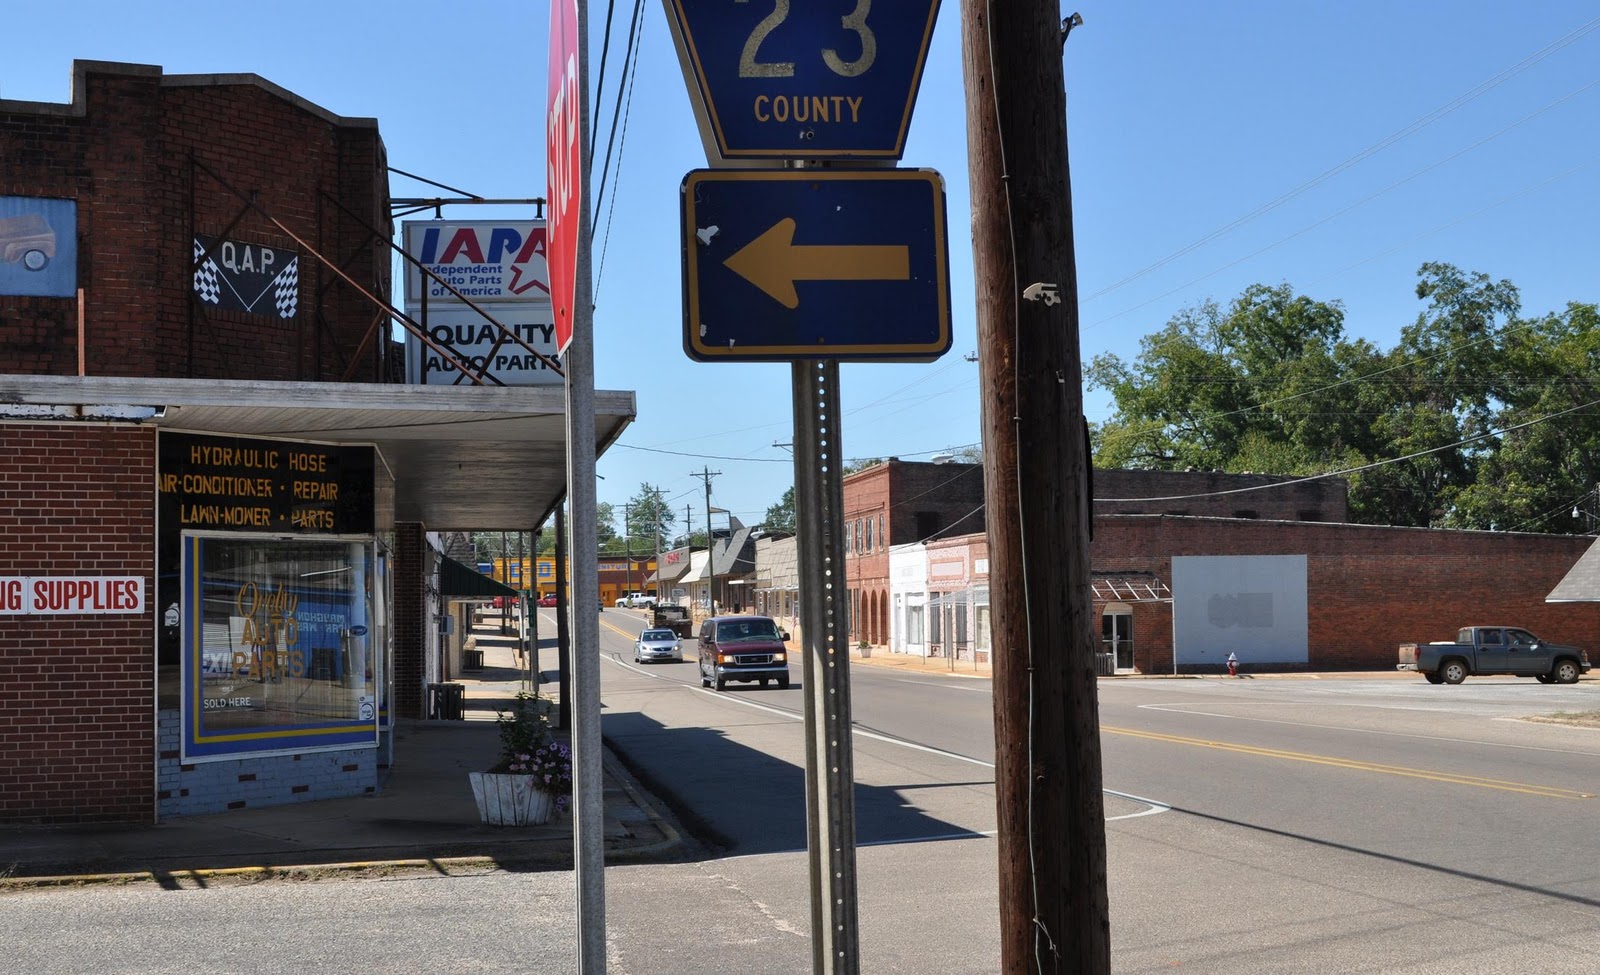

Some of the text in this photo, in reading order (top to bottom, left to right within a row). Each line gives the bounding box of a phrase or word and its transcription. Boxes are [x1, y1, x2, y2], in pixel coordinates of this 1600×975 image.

[734, 0, 877, 78] 23
[754, 95, 863, 122] COUNTY
[549, 52, 576, 243] STOP
[420, 228, 547, 264] IAPA
[431, 287, 446, 296] of
[469, 275, 502, 285] Parts
[430, 323, 555, 346] QUALITY
[495, 354, 562, 371] PARTS
[191, 445, 327, 473] HYDRAULIC HOSE
[294, 481, 338, 500] REPAIR
[291, 510, 334, 529] PARTS
[33, 580, 139, 611] SUPPLIES
[237, 581, 298, 618] Quality
[241, 617, 299, 646] AUTO
[232, 651, 305, 680] PARTS
[203, 697, 251, 709] SOLD HERE
